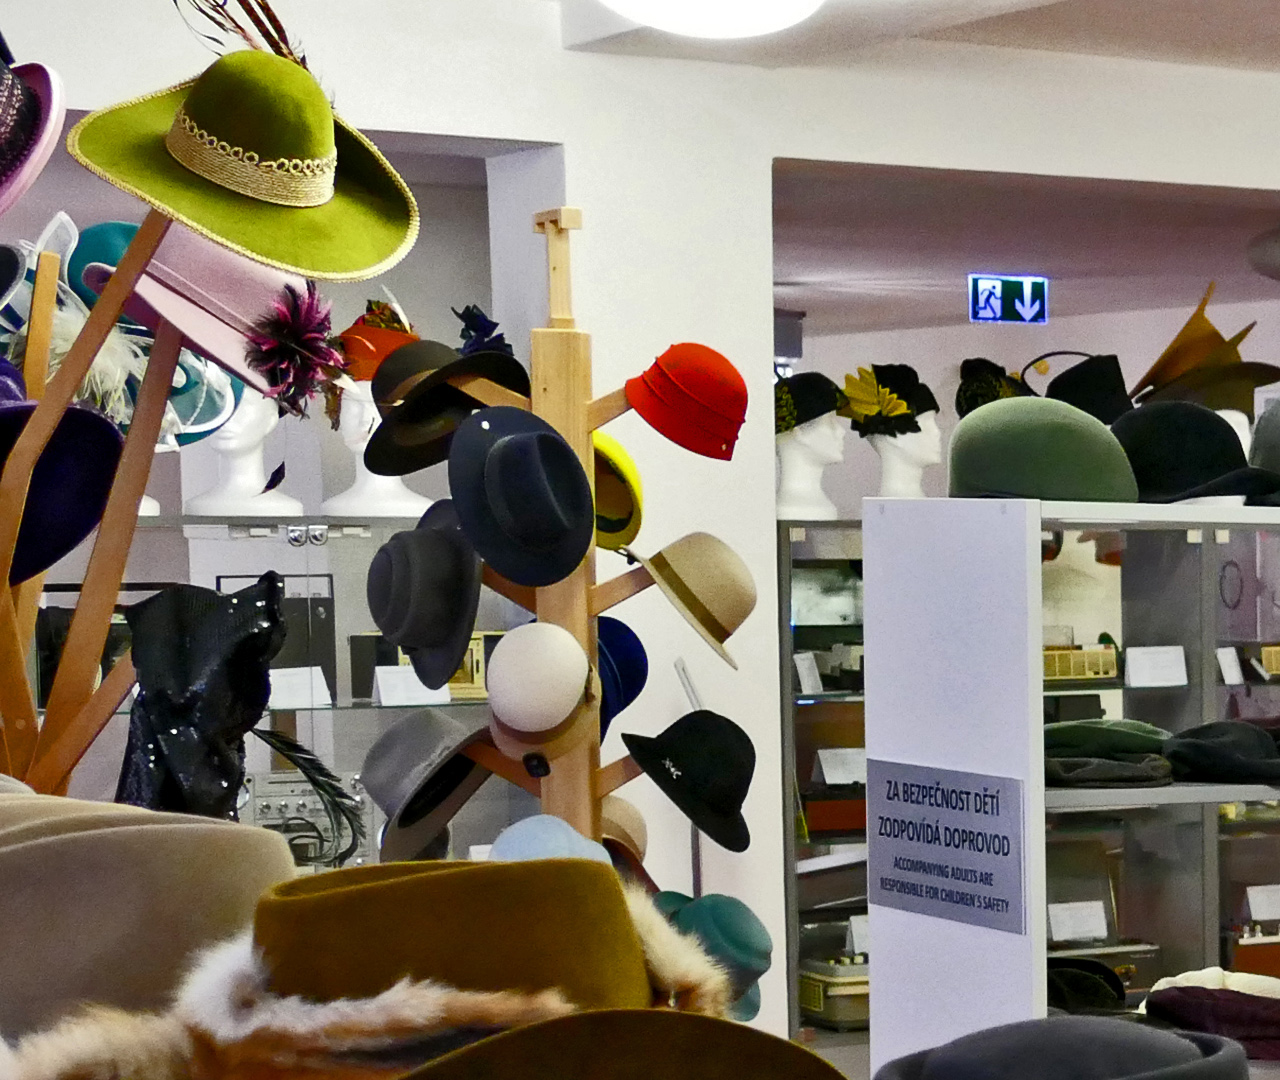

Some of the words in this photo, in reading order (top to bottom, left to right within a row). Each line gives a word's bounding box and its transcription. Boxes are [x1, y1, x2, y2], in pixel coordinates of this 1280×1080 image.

[886, 780, 900, 802] ZA
[902, 781, 971, 812] BEZPEČNOST
[974, 787, 1000, 816] DĚTÍ
[878, 816, 942, 846] ZODPOVÍDÁ
[944, 827, 1010, 857] DOPROVOD
[893, 856, 950, 879] ACCOMPANYING
[950, 867, 978, 884] ADULTS
[979, 871, 994, 887] ARE
[880, 877, 924, 898] RESPONSIBLE
[925, 885, 939, 900] FOR
[982, 895, 1010, 913] SAFETY
